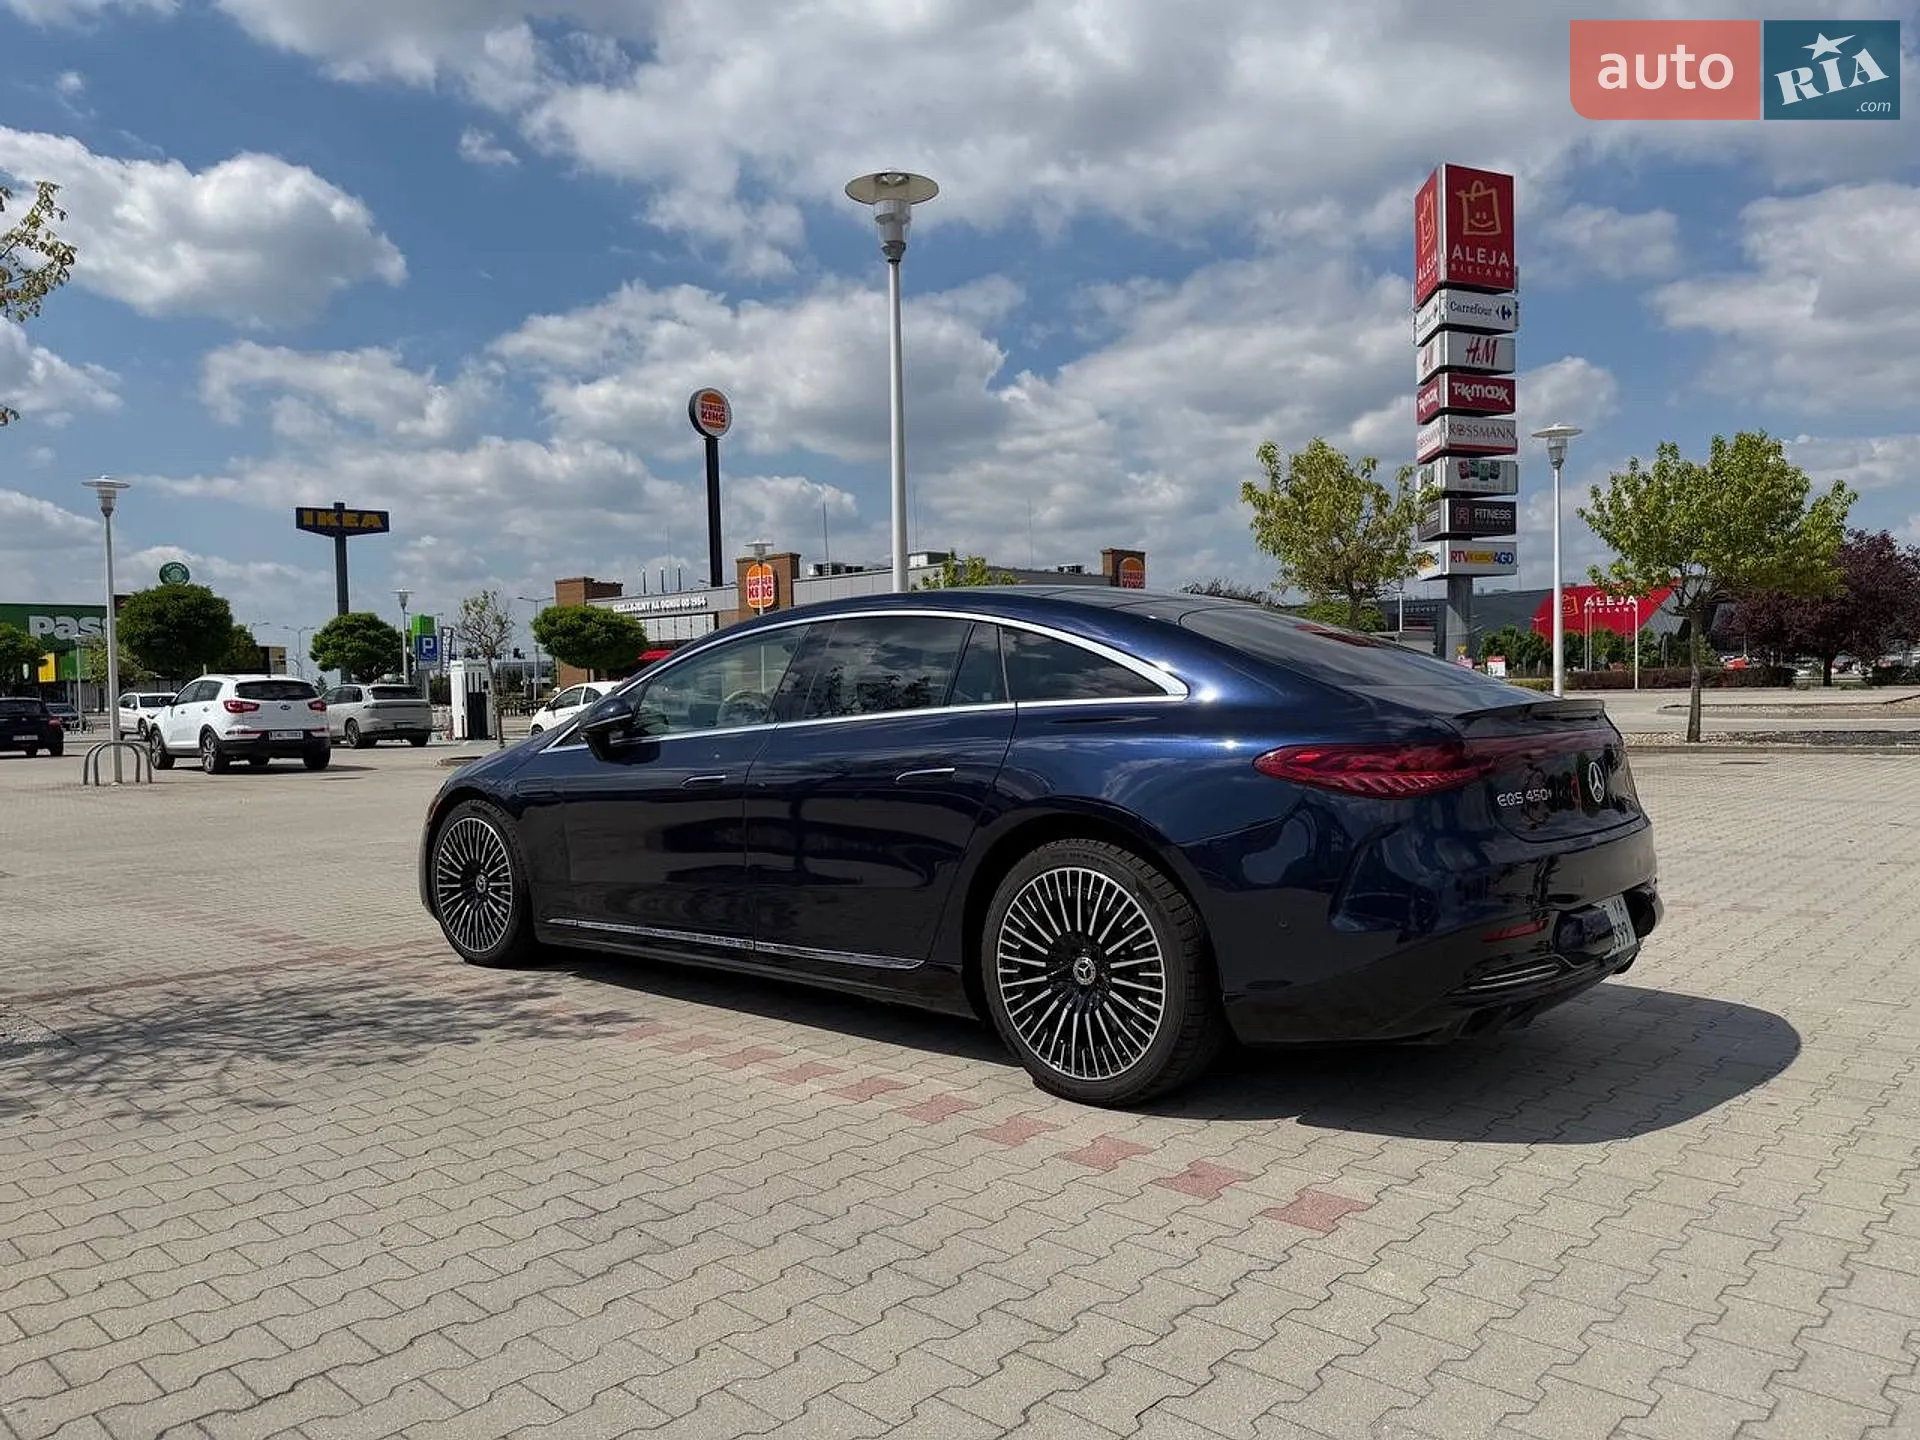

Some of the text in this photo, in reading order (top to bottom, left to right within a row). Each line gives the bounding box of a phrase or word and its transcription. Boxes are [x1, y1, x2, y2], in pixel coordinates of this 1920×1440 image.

[1452, 244, 1509, 267] ALEJA
[1450, 263, 1510, 279] BIELANY
[1450, 301, 1492, 316] Carrefour
[1465, 336, 1497, 367] H&M
[701, 410, 726, 423] KING
[1449, 423, 1515, 440] ROSSMANN
[302, 510, 383, 528] IKEA
[1474, 508, 1511, 519] FITNESS
[1450, 551, 1469, 564] RTV
[1584, 595, 1636, 606] ALEJA
[422, 638, 433, 653] P
[1497, 792, 1524, 807] EQS
